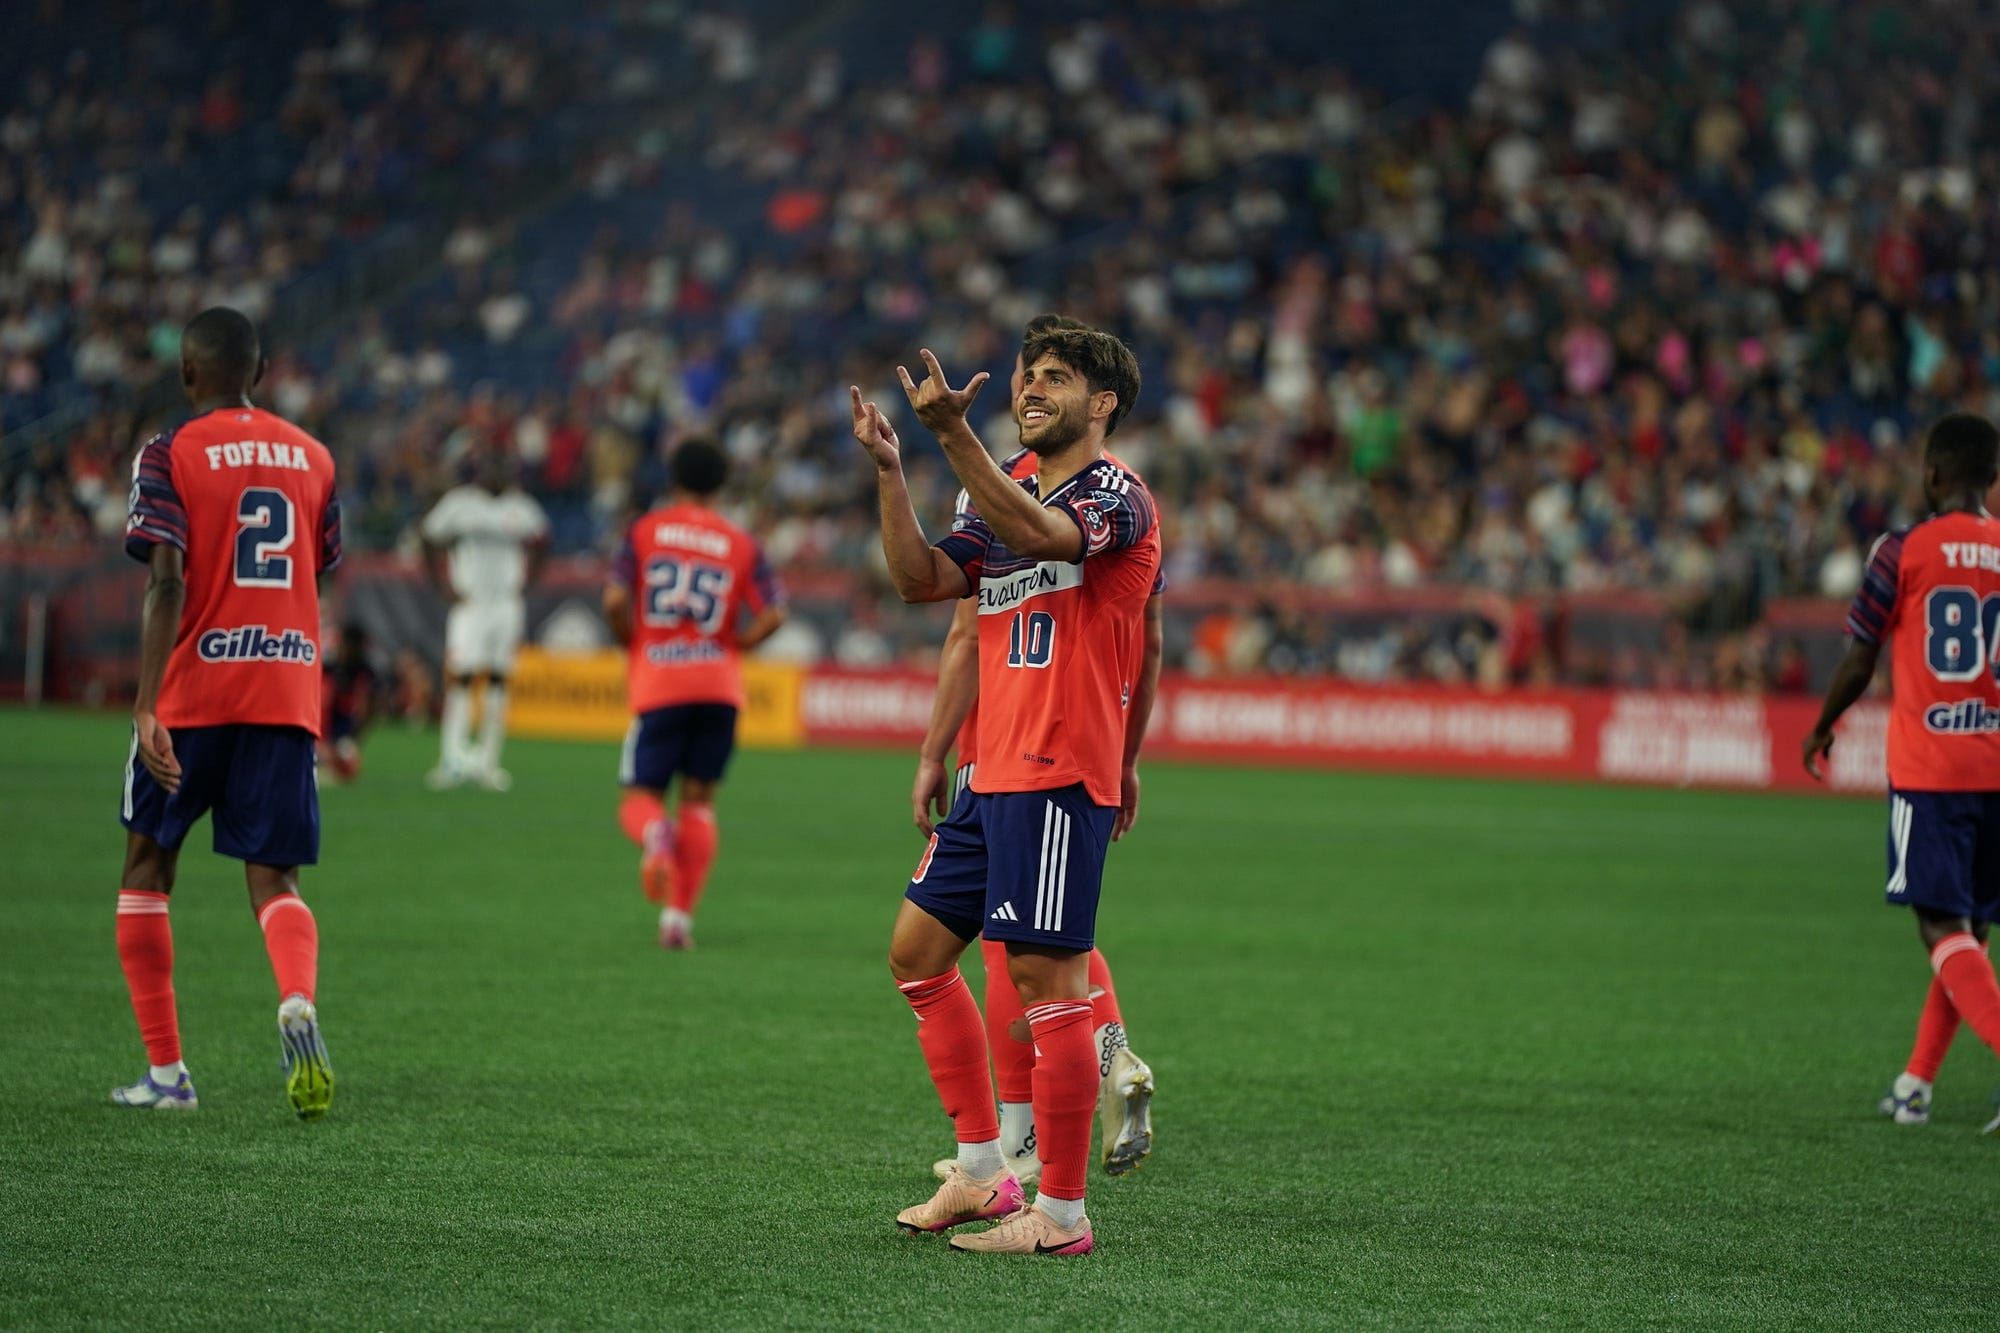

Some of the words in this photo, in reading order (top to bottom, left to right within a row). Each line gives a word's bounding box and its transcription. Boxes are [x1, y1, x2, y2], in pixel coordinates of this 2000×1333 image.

[204, 440, 311, 472] FOFANA
[233, 486, 295, 589] 2
[643, 552, 735, 637] 25
[197, 624, 317, 667] Gillette
[1007, 610, 1057, 670] 10
[1923, 697, 2000, 736] Gille
[1037, 756, 1055, 766] 1996
